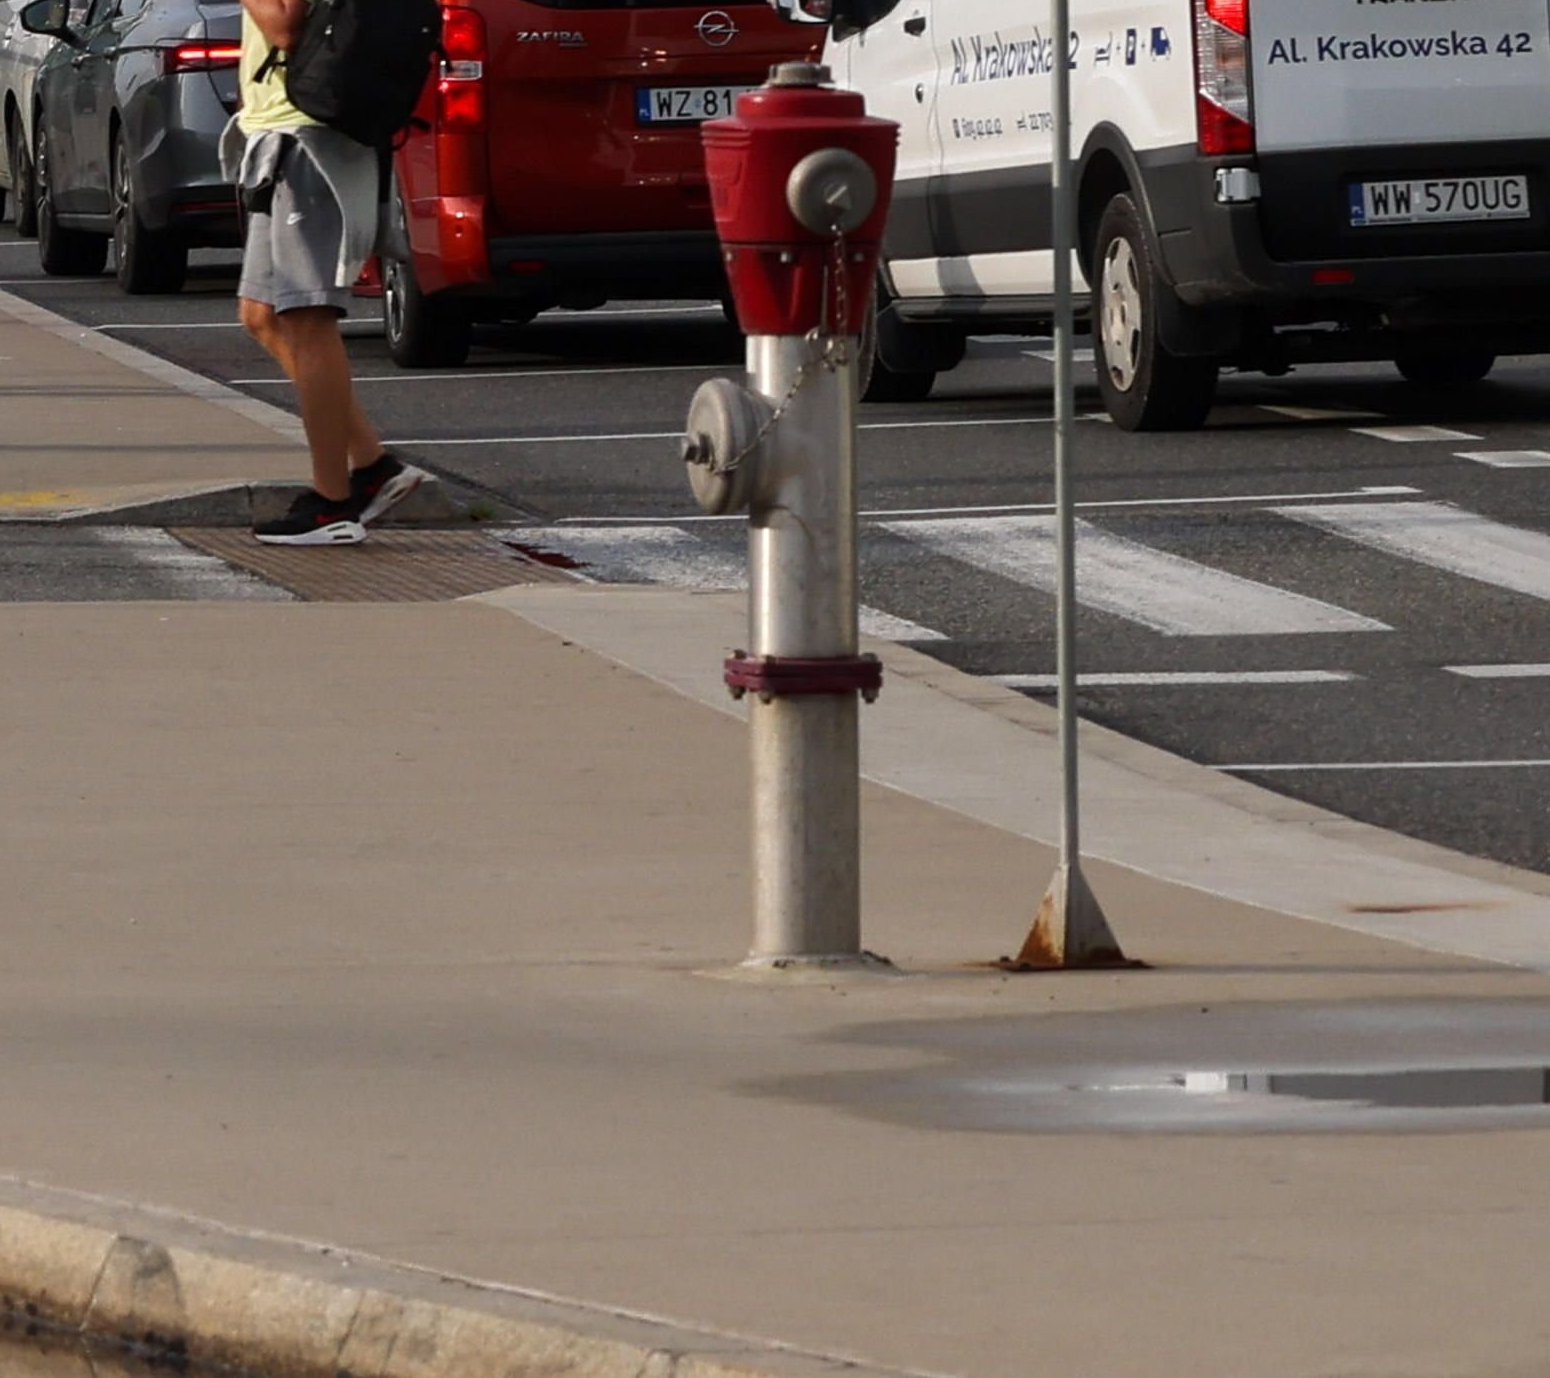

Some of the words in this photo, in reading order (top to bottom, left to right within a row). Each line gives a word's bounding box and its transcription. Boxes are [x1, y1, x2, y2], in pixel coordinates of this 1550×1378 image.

[517, 31, 585, 42] ZAFIRA
[1268, 40, 1307, 64] Al.
[1317, 31, 1488, 61] Krakowska
[1496, 32, 1533, 57] 42
[657, 91, 691, 118] WZ
[1371, 184, 1412, 215] WW
[1425, 179, 1521, 212] 570UG
